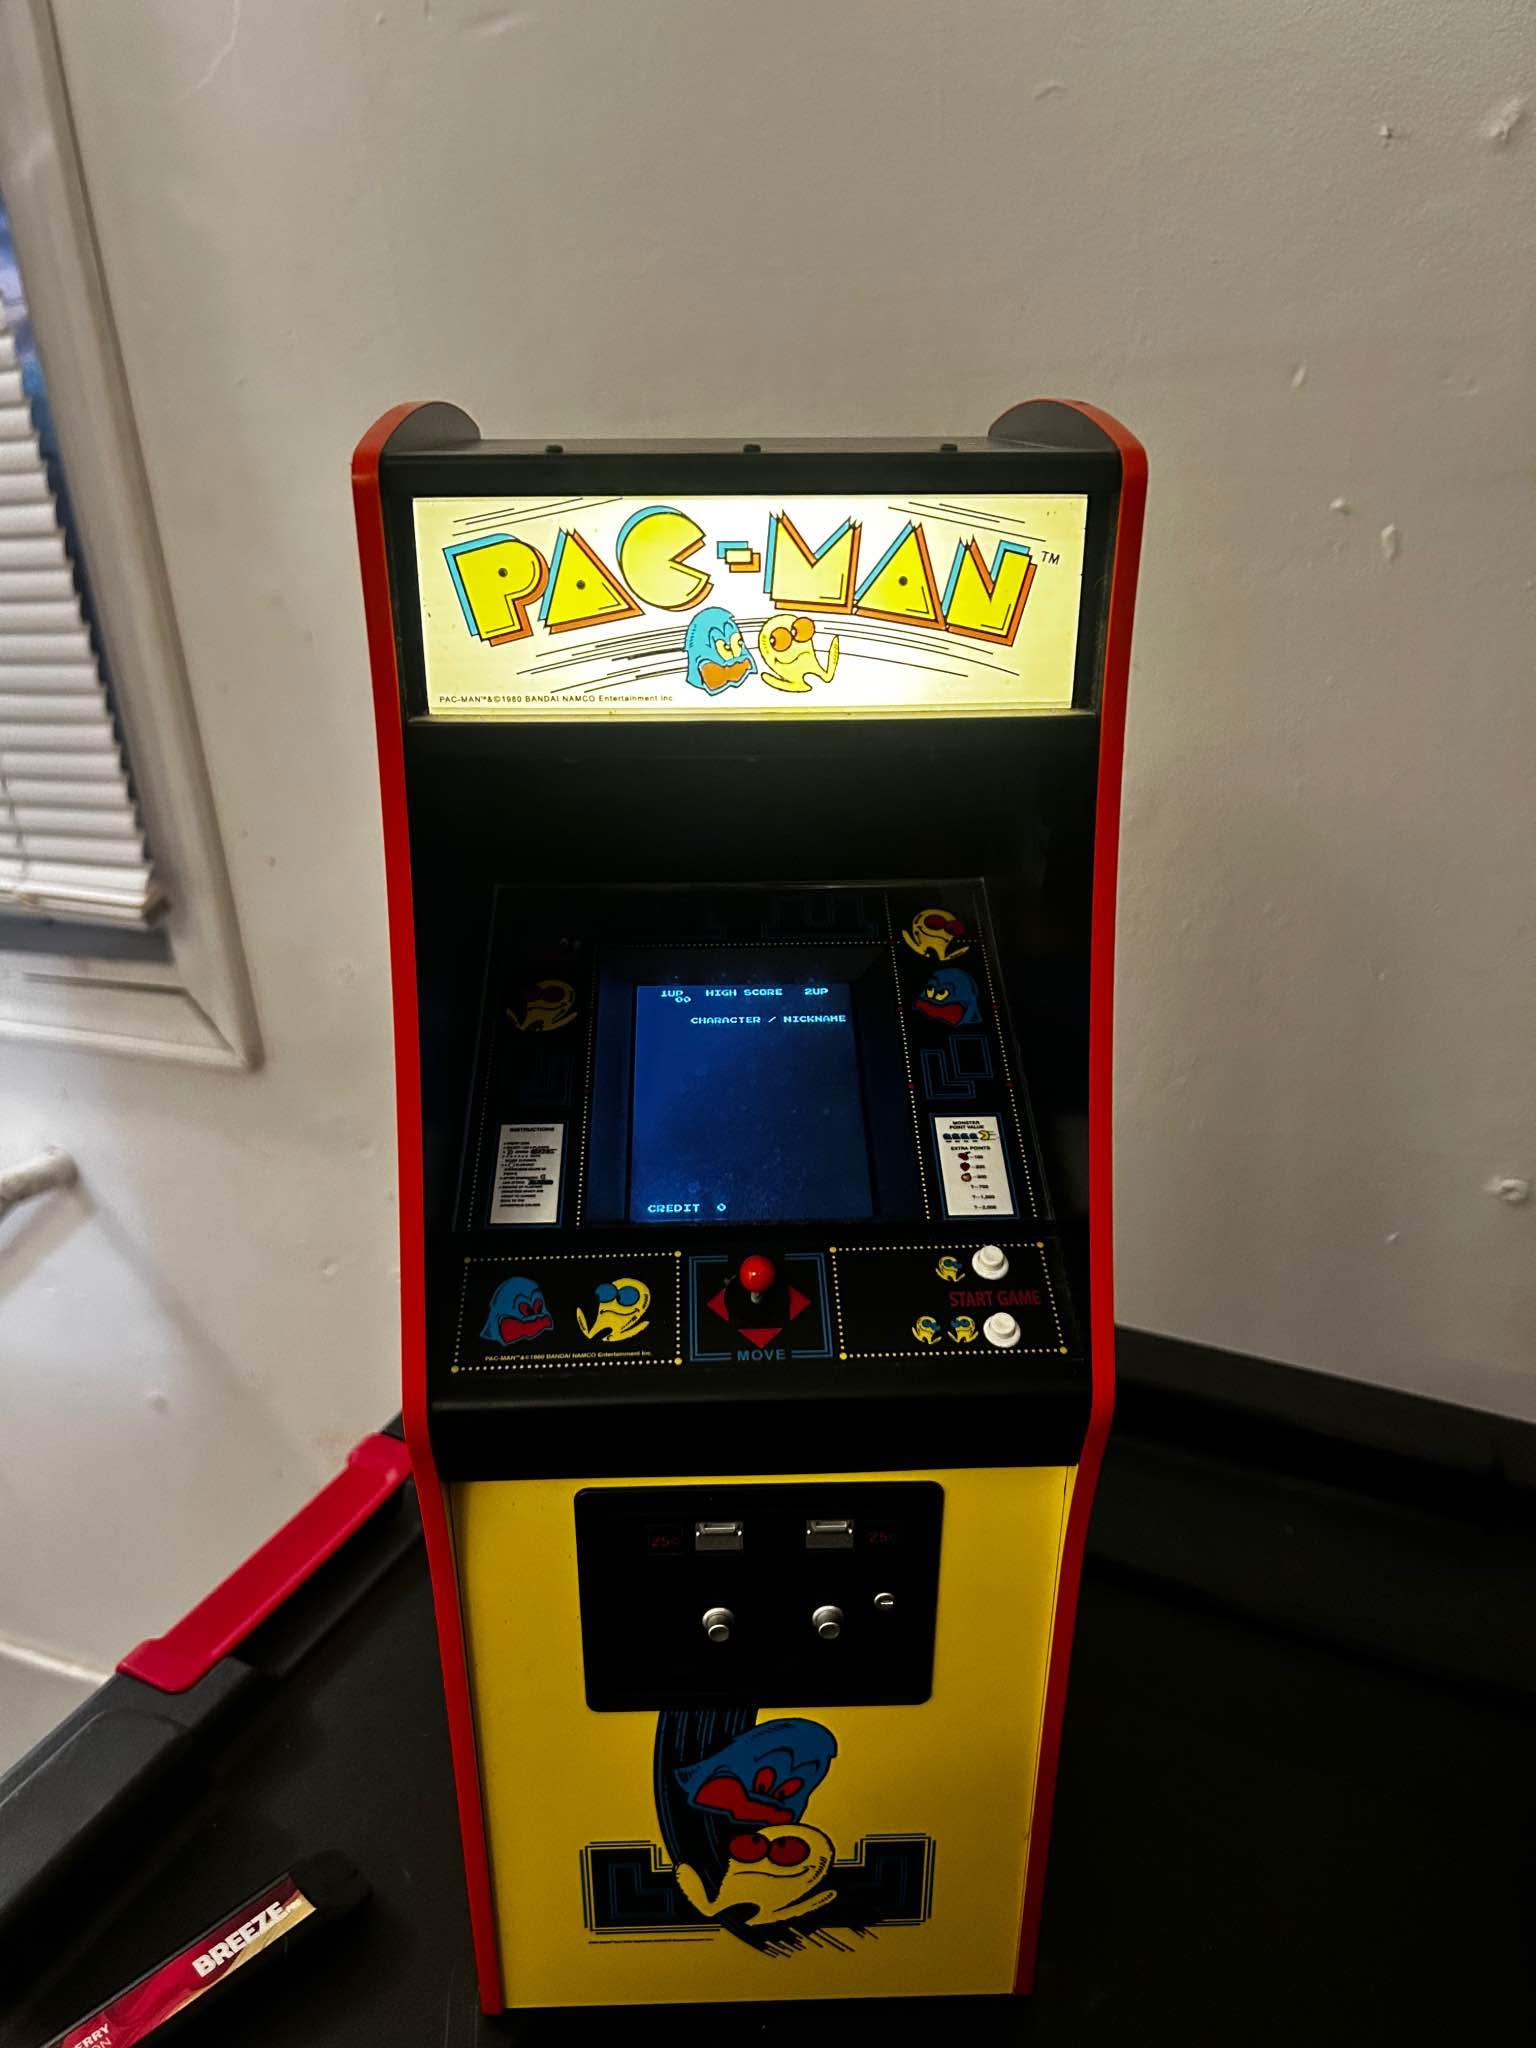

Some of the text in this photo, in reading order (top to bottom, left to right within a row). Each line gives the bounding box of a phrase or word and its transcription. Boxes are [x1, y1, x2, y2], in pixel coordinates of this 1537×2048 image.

[442, 505, 1037, 647] PAC-MAN
[743, 988, 783, 996] SCORE
[690, 1016, 761, 1024] CHARACTER
[783, 1015, 847, 1023] NICKNAME
[647, 1203, 727, 1213] CREDIT 0
[949, 1290, 1041, 1307] START GAME
[737, 1349, 785, 1361] MOVE
[192, 1901, 290, 1978] BREEZE
